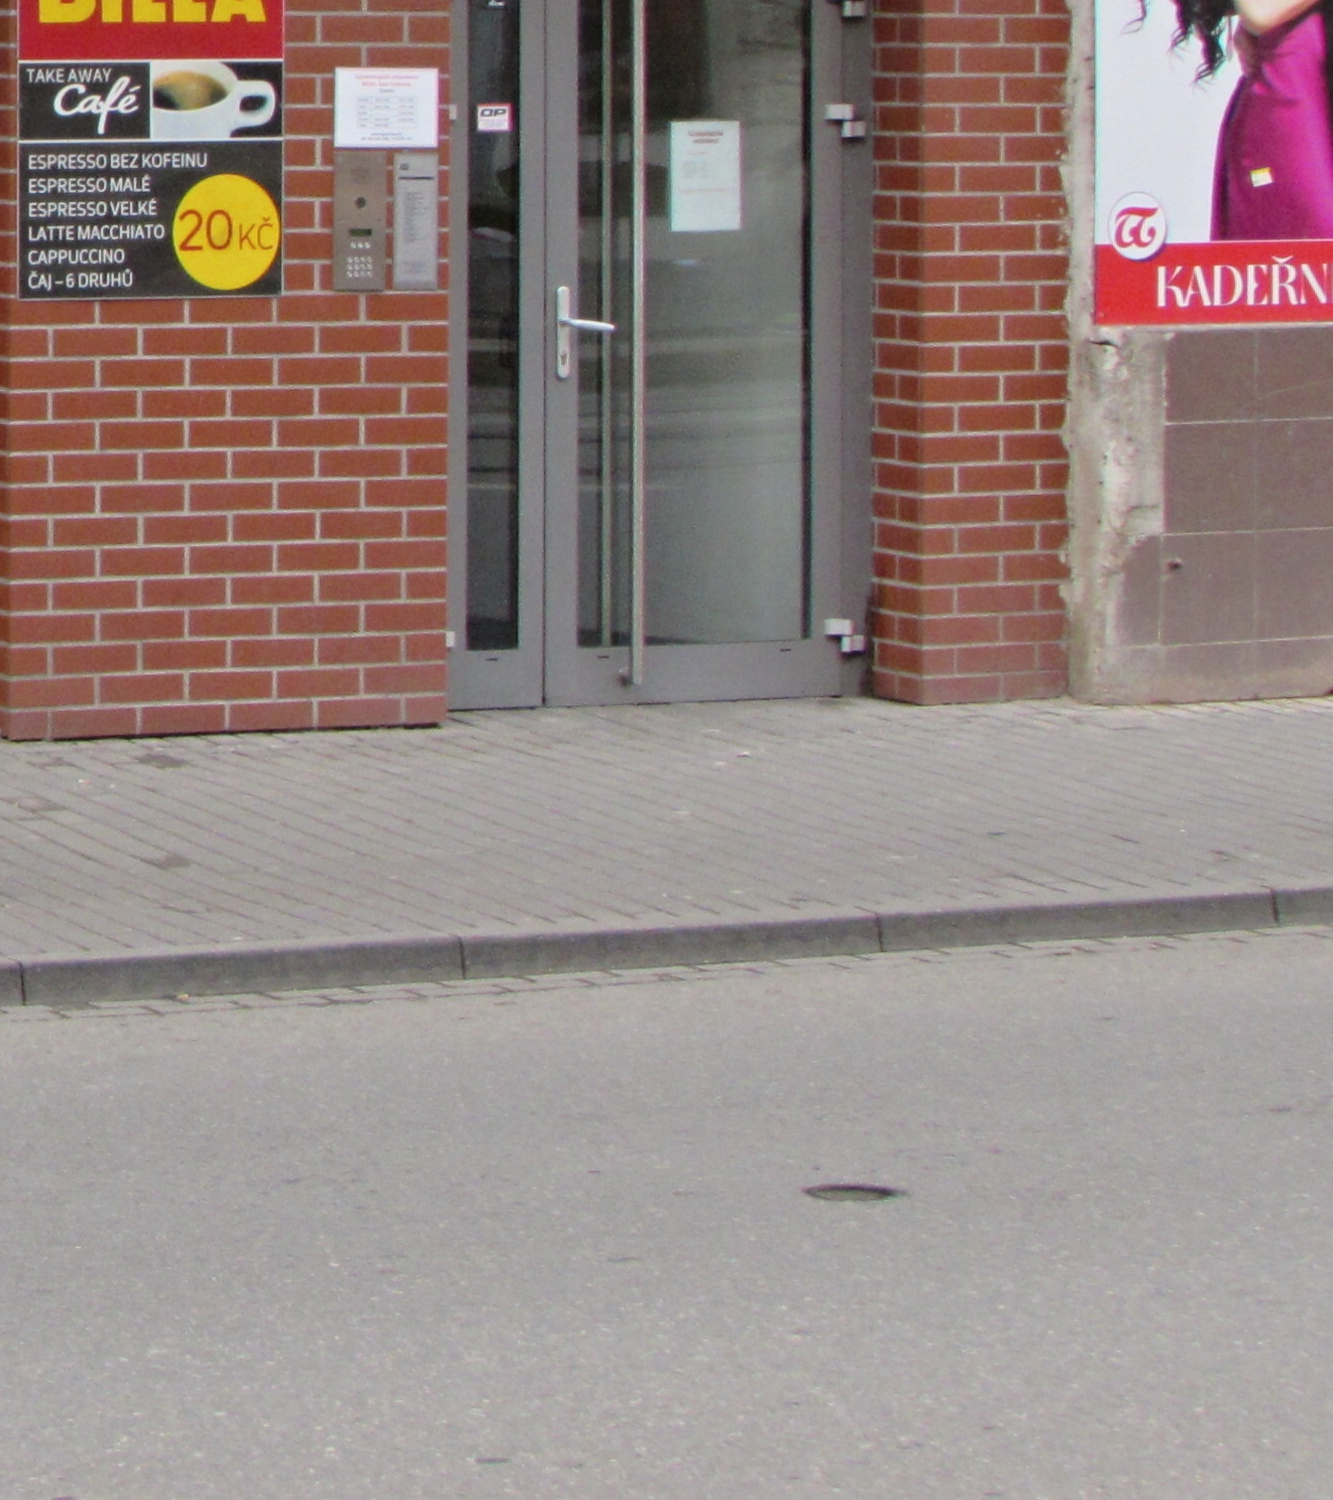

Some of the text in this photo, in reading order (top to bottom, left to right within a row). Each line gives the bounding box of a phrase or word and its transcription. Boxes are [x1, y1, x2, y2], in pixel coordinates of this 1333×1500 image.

[26, 68, 112, 83] TAKE AWAY
[53, 76, 140, 135] Café
[28, 153, 208, 170] ESPRESSO BEZ KOFEINU
[28, 175, 151, 194] ESPRESSO MALÉ
[28, 198, 157, 217] ESPRESSO VELKÉ
[28, 224, 165, 241] LATTE MACCHIATO
[178, 210, 233, 250] 20
[28, 249, 125, 265] CAPPUCCINO
[28, 270, 52, 291] ČAJ
[66, 273, 74, 288] 6
[78, 269, 133, 288] DRUHŮ
[1157, 255, 1333, 308] KADEŘN
